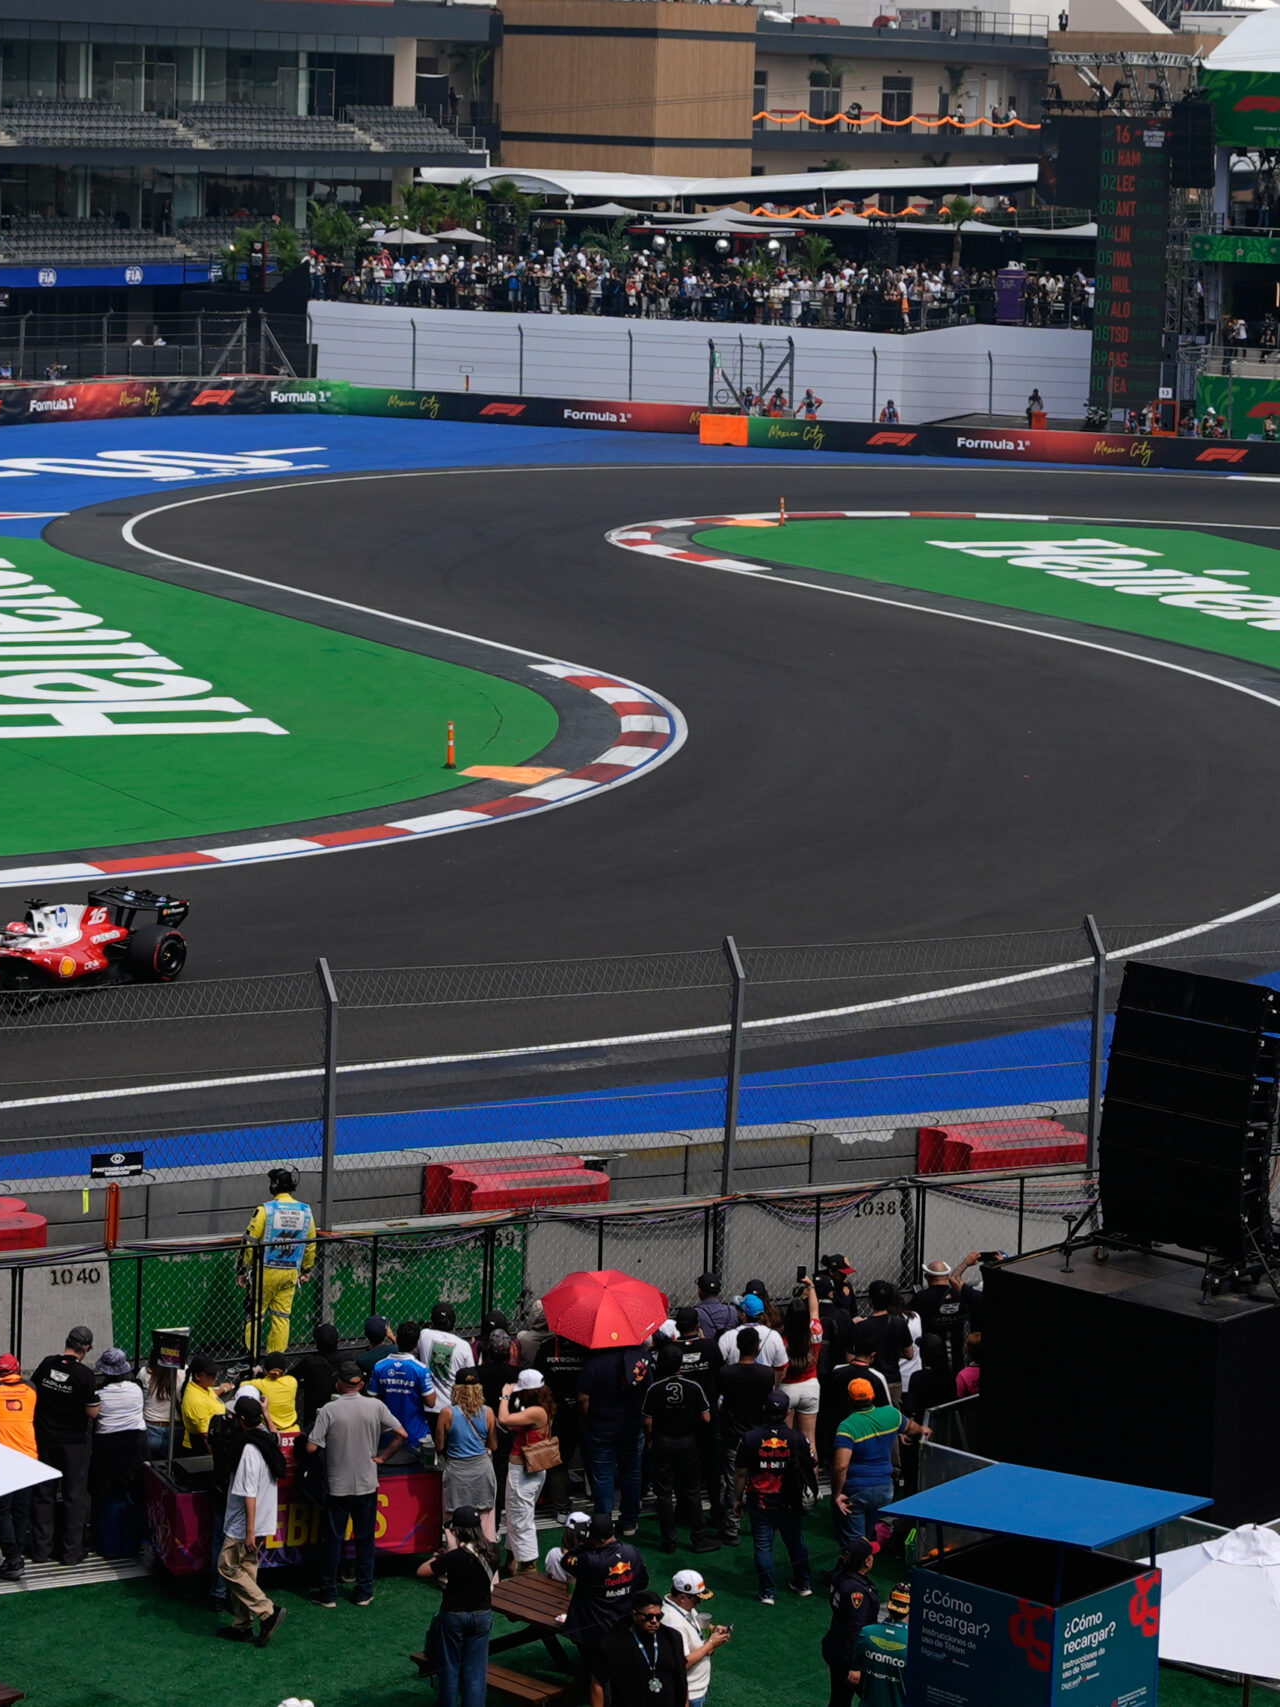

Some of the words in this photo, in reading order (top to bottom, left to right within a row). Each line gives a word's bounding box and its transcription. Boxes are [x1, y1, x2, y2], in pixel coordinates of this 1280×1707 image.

[1116, 125, 1131, 143] 16
[1118, 150, 1141, 166] HAM
[1101, 175, 1116, 190] 02
[1116, 175, 1135, 192] LEC
[1101, 201, 1115, 215] 03
[1115, 201, 1136, 216] ANT
[665, 229, 707, 237] PADDOCK
[1100, 225, 1114, 240] 04
[1114, 226, 1131, 242] LIN
[1098, 250, 1113, 265] 05
[39, 271, 55, 283] FIA
[126, 269, 141, 280] FIA
[1096, 276, 1111, 290] 06
[1112, 277, 1131, 293] HUL
[1096, 302, 1110, 316] 07
[1110, 302, 1130, 318] ALO
[1095, 326, 1109, 340] 08
[1110, 327, 1129, 343] TSO
[29, 398, 68, 412] Formula
[270, 391, 317, 402] Formula
[387, 394, 416, 408] Mexico
[420, 394, 440, 419] City
[563, 408, 617, 422] Formula
[768, 424, 800, 438] Mexico
[802, 426, 826, 449] City
[957, 437, 1014, 451] Formula
[1093, 441, 1127, 456] Mexico
[1130, 441, 1154, 467] City
[88, 907, 107, 925] 16
[92, 1164, 142, 1173] PHOTOGRAPHERS
[854, 1201, 896, 1218] 1038
[680, 1361, 709, 1370] ADILLAC
[665, 1382, 684, 1403] 3
[923, 1589, 973, 1614] ¿Cómo
[923, 1608, 990, 1639] recargar?
[1064, 1612, 1103, 1638] ¿Cómo
[922, 1625, 967, 1647] Instrucciones
[967, 1640, 976, 1650] de
[922, 1636, 934, 1645] uso
[934, 1638, 943, 1648] de
[1063, 1621, 1116, 1655] recargar?
[865, 1650, 906, 1668] aramco
[1062, 1650, 1098, 1670] Instrucciones
[1098, 1647, 1106, 1656] de
[1062, 1669, 1072, 1679] uso
